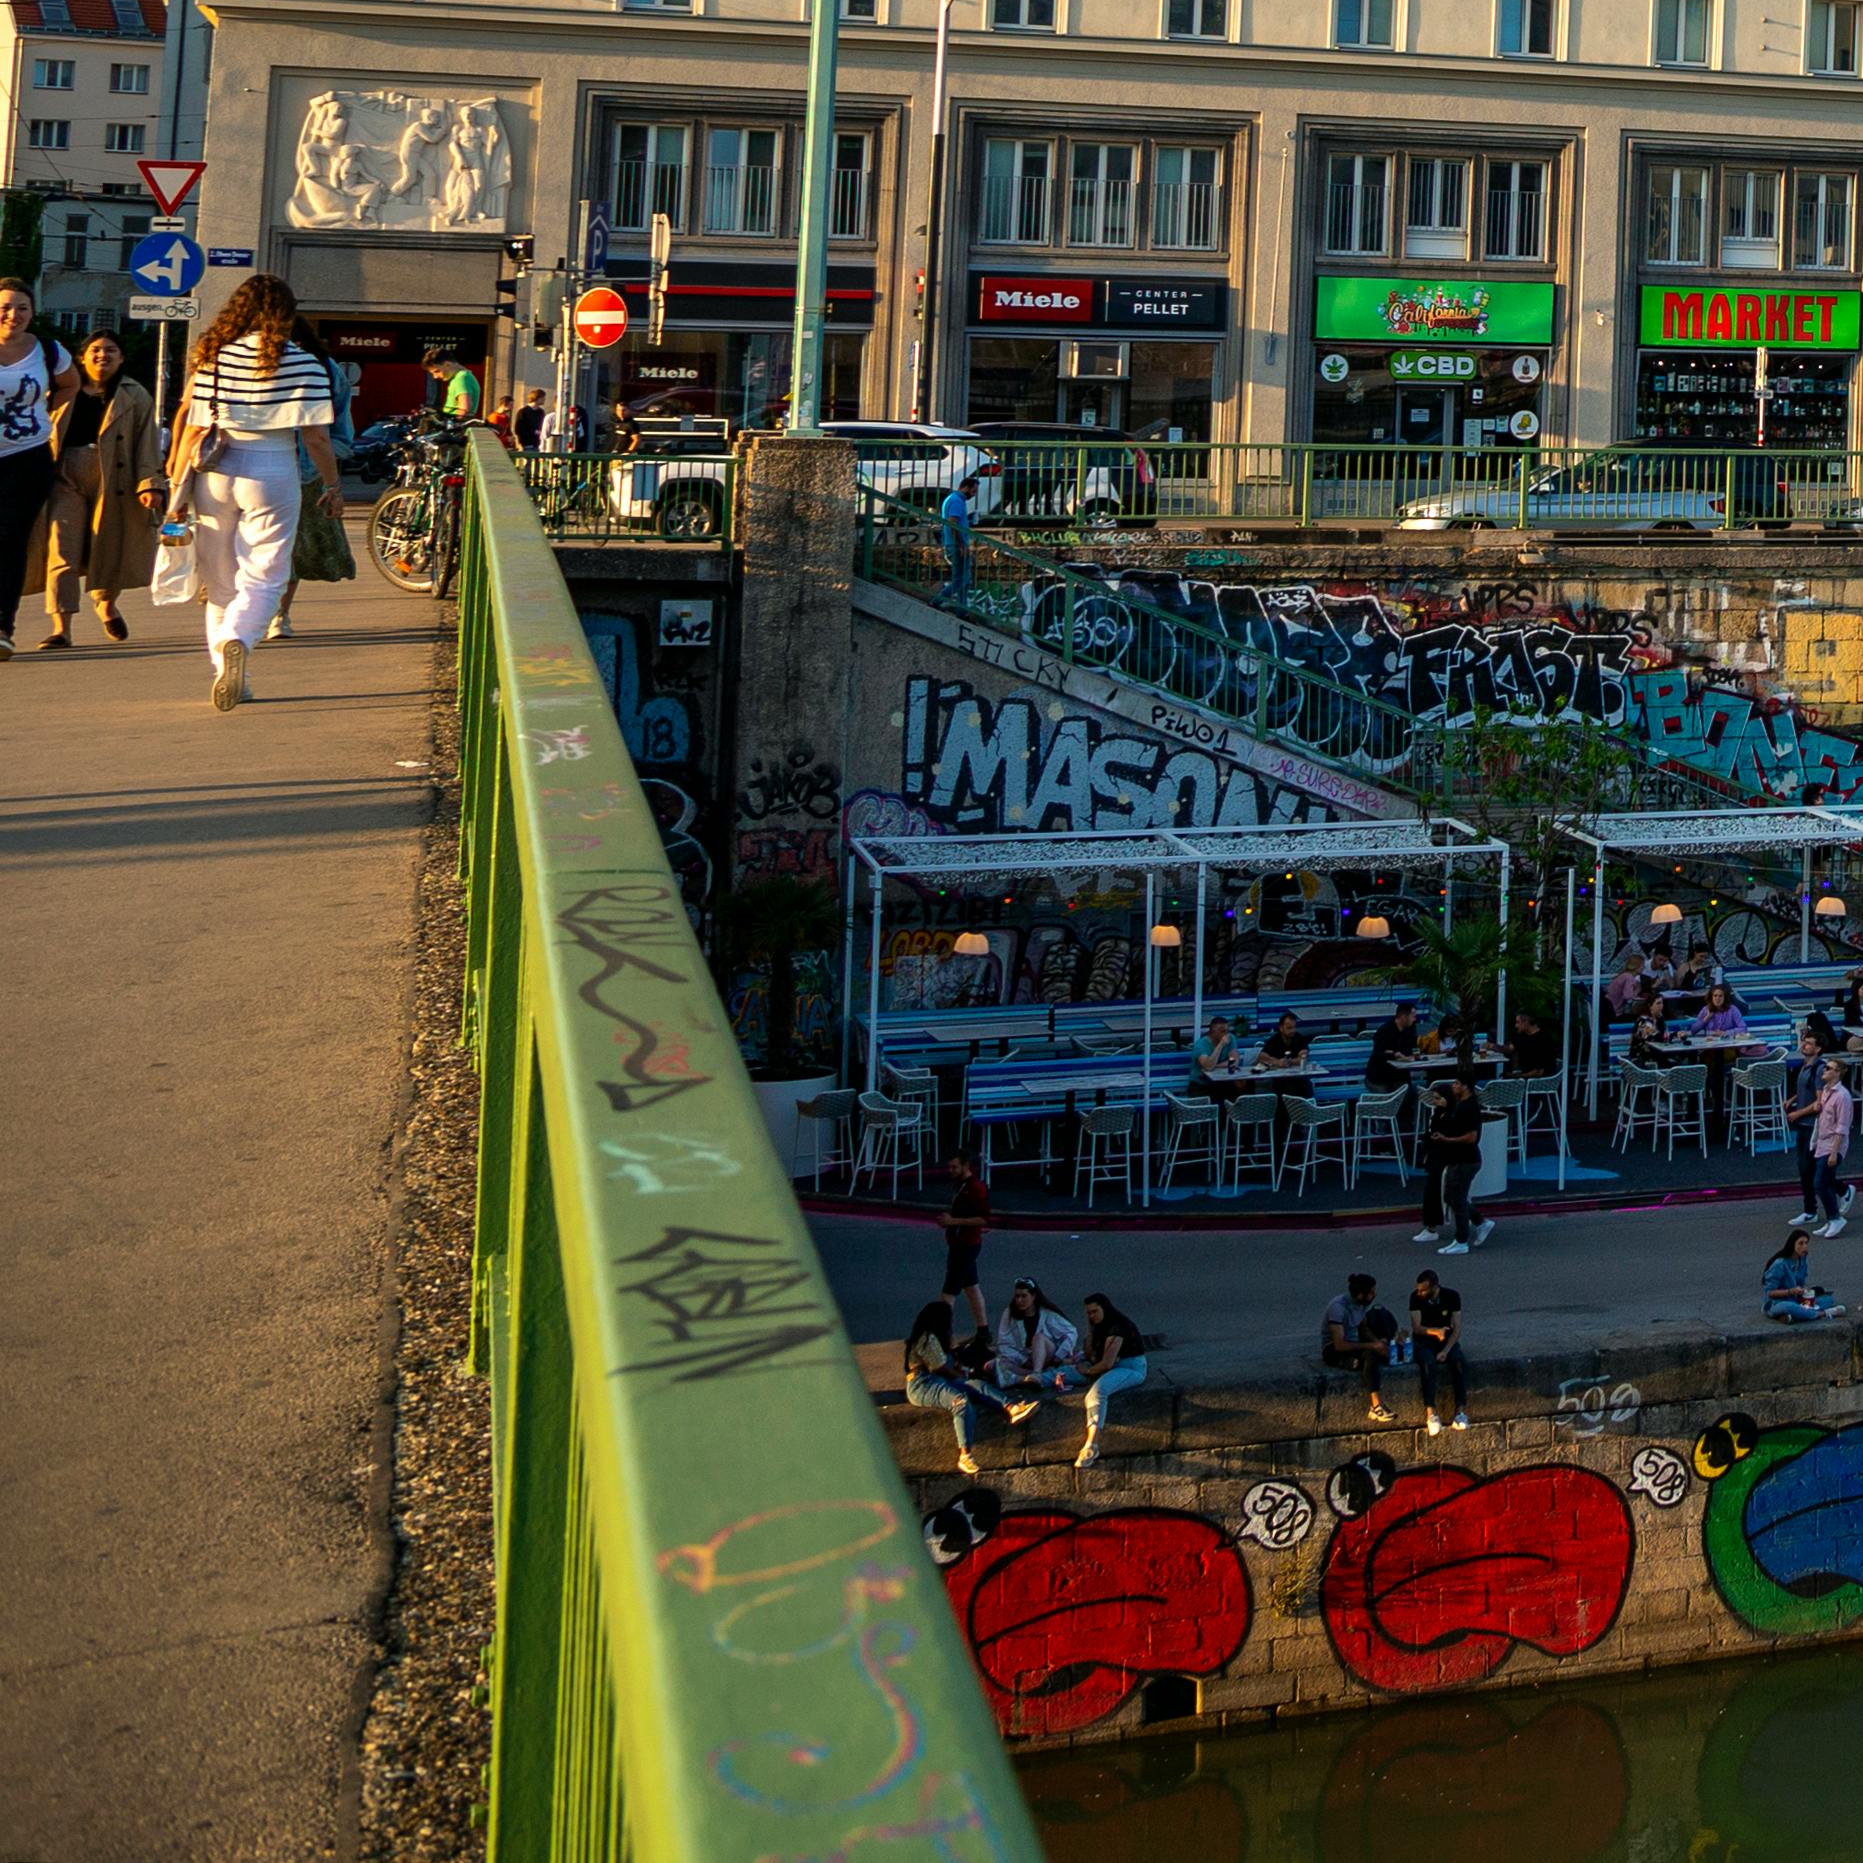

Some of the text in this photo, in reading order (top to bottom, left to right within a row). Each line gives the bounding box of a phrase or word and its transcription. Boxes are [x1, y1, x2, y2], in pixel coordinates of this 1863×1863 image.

[995, 291, 1080, 309] Miele
[1136, 290, 1188, 299] CENTER
[1133, 303, 1189, 315] PELLET
[1662, 292, 1838, 342] MARKET
[340, 336, 391, 347] Miele
[639, 366, 699, 379] Miele
[1417, 356, 1475, 375] CBD
[1637, 1449, 1683, 1502] 508
[1252, 1483, 1310, 1544] 508
